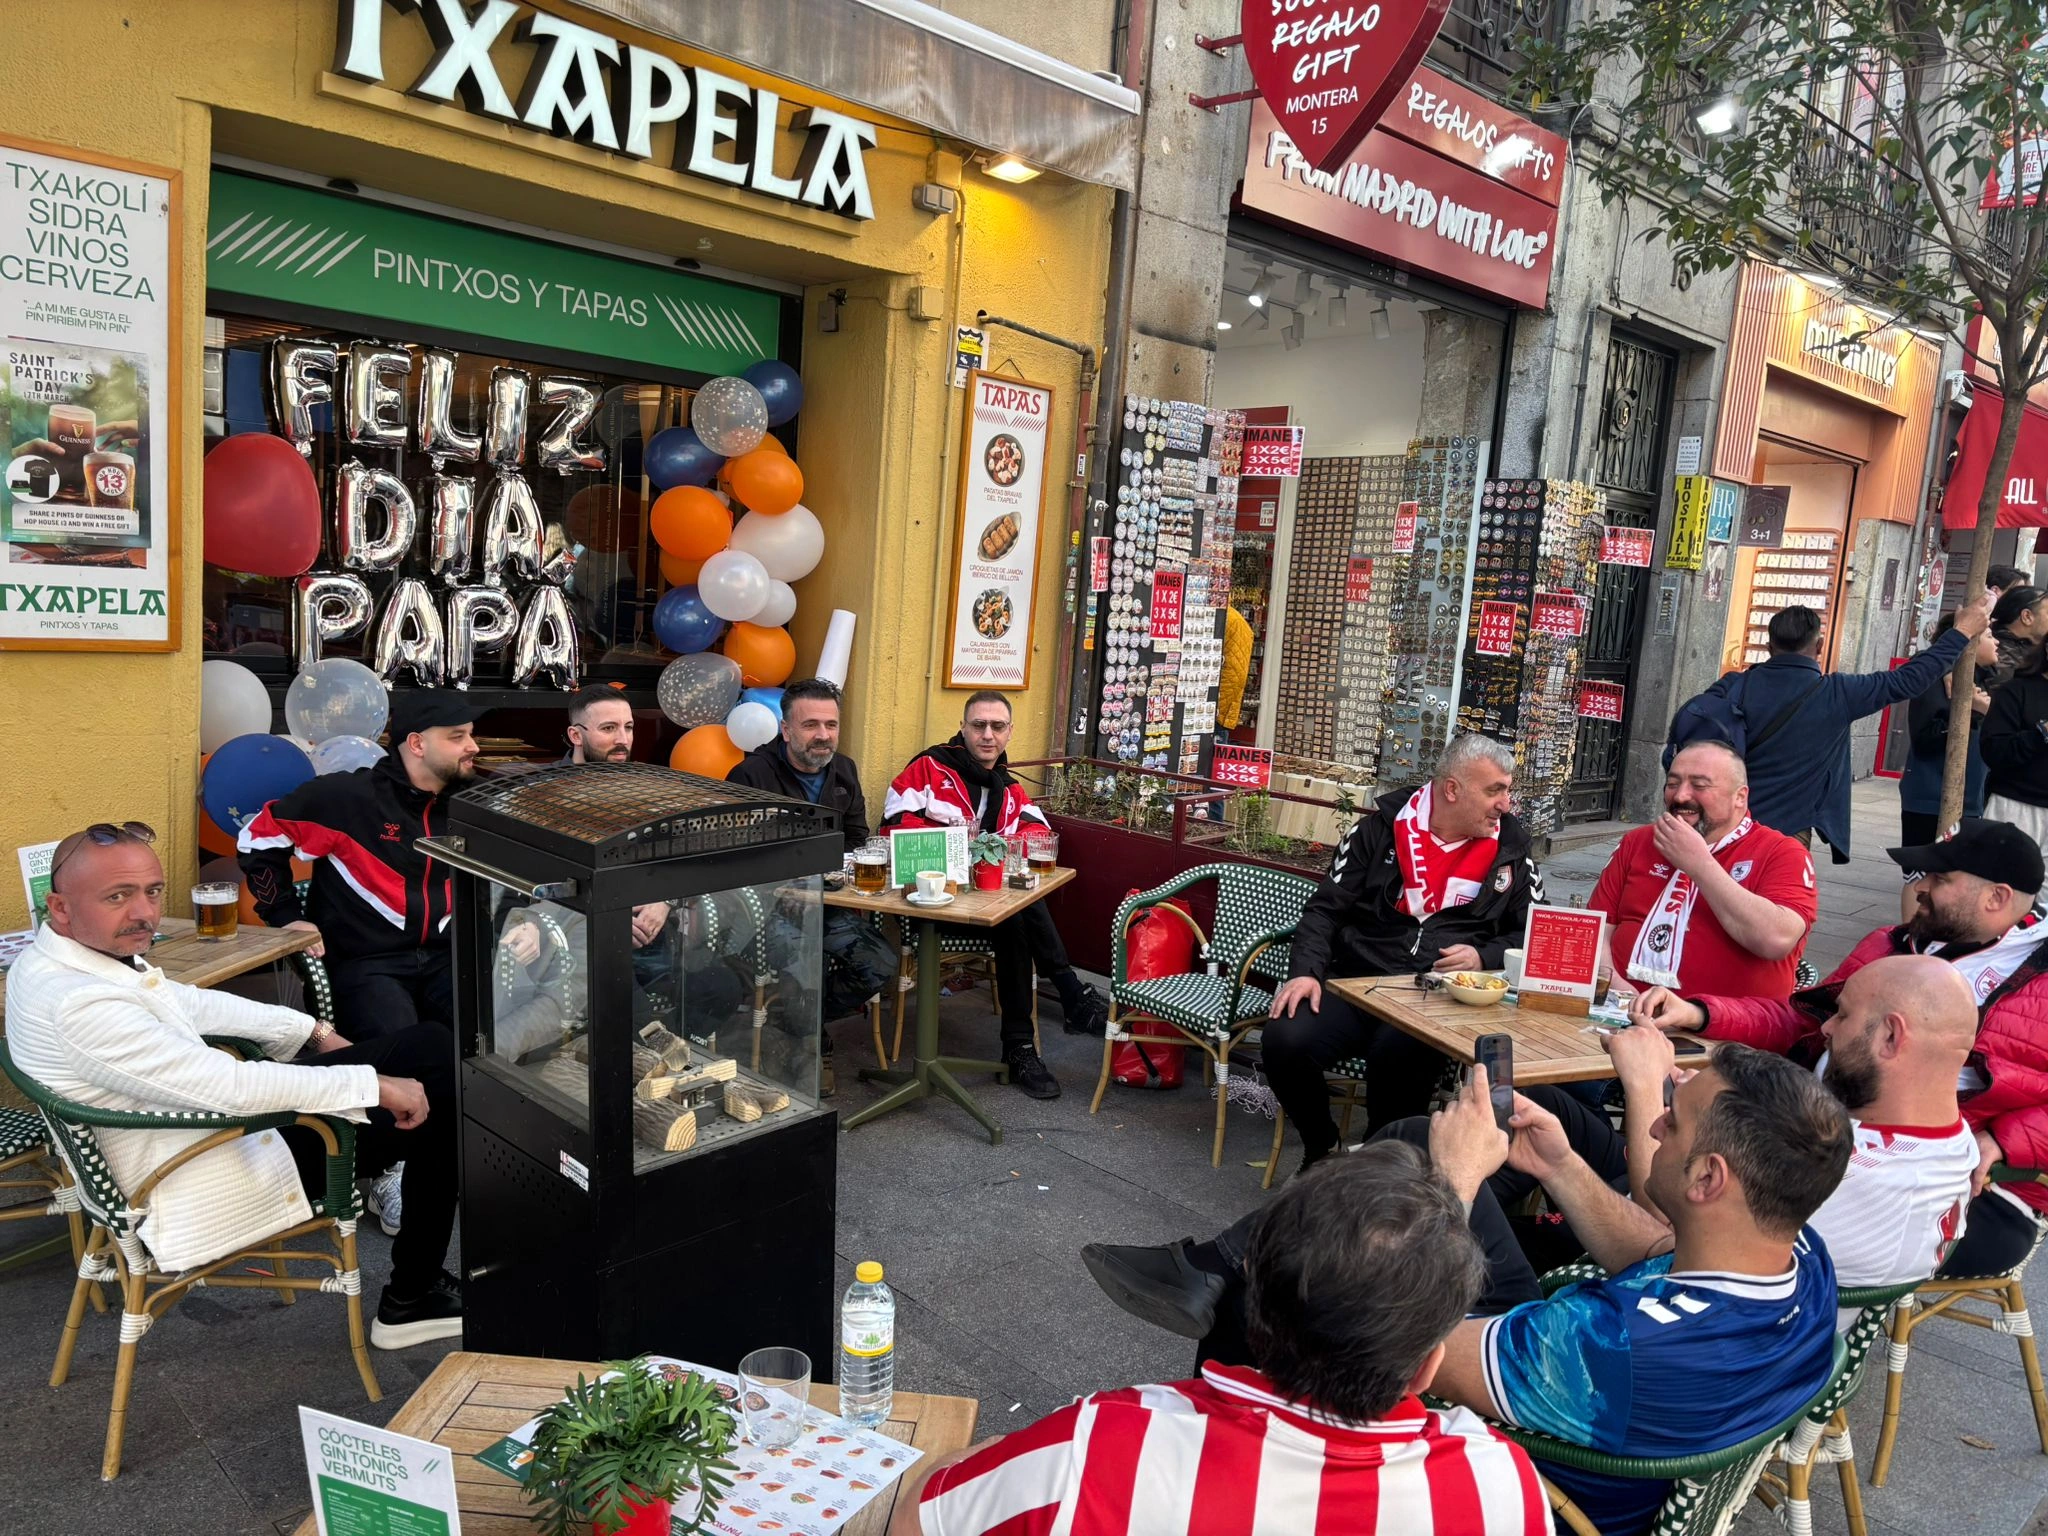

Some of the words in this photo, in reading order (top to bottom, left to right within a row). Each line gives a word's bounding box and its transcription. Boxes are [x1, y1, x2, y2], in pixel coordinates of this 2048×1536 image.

[1271, 4, 1380, 53] REGALO
[1292, 44, 1360, 83] GIFT
[340, 0, 877, 220] TXAPELA
[1286, 86, 1358, 114] MONTERA
[1312, 117, 1328, 135] 15
[1407, 81, 1497, 153] REGALOS
[6, 161, 148, 213] TXAKOLÍ
[28, 198, 128, 239] SIDRA
[1343, 162, 1437, 229] MADRID
[1437, 195, 1492, 255] WITH
[26, 227, 129, 268] VINOS
[0, 255, 155, 302] CERVEZA
[373, 247, 521, 304] PINTXOS
[528, 280, 554, 309] Y
[554, 284, 648, 328] TAPAS
[26, 311, 44, 322] PIN
[47, 313, 87, 328] PIRIBIM
[89, 320, 107, 331] PIN
[45, 302, 58, 313] MI
[60, 305, 77, 316] ME
[80, 308, 116, 321] GUSTA
[118, 314, 132, 324] EL
[10, 352, 55, 368] SAINT
[15, 366, 94, 385] PATRICK'S
[24, 391, 41, 401] 17TH
[44, 393, 70, 402] MARCH
[35, 381, 63, 394] DAY
[981, 382, 1042, 415] TAPAS
[271, 337, 608, 476] FELIZ
[102, 475, 123, 489] 13
[2004, 477, 2038, 504] ALL
[56, 511, 74, 519] PINTS
[1674, 477, 1692, 555] HOSTAL
[1751, 529, 1771, 540] 3+1
[0, 583, 166, 616] TXAPELA
[40, 619, 80, 630] PINTXOS
[81, 621, 87, 630] Y
[90, 621, 119, 631] TAPAS
[1216, 745, 1271, 763] MANES
[1664, 869, 1692, 916] SAM
[1540, 983, 1573, 993] TXAPELA
[318, 1427, 401, 1462] CÓCTELES
[320, 1443, 347, 1462] GIN
[348, 1451, 408, 1479] TONICS
[322, 1458, 397, 1491] VERMUTS
[711, 1520, 743, 1536] PINTXO
